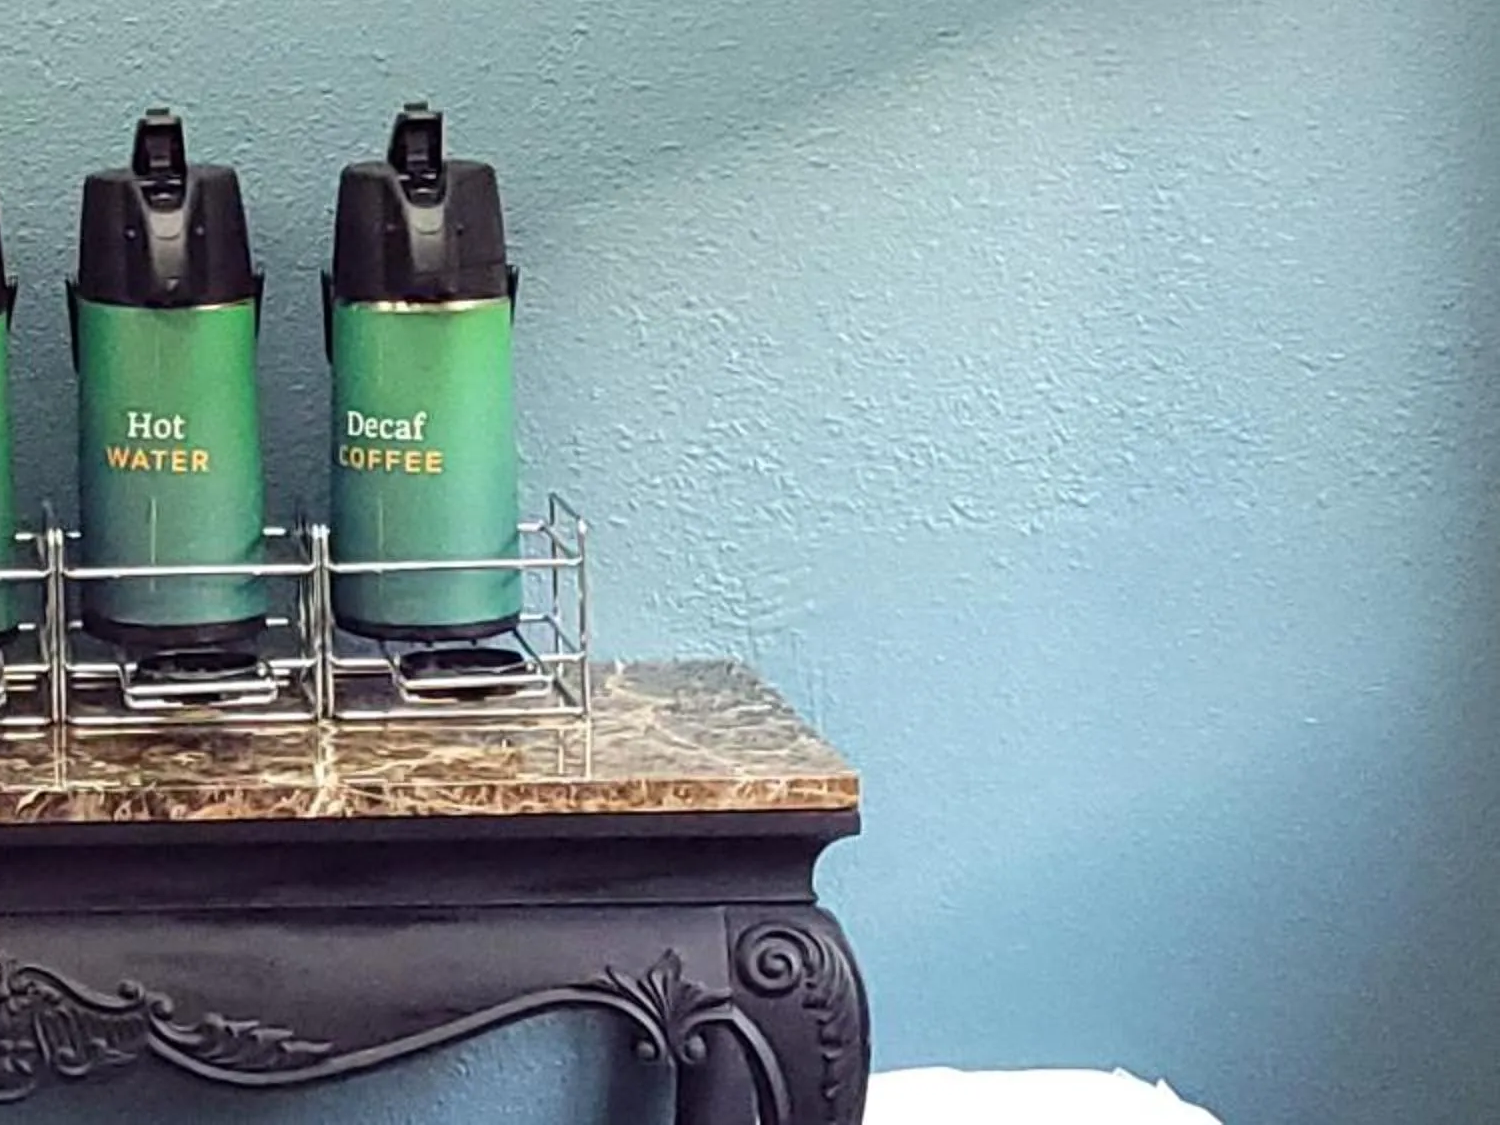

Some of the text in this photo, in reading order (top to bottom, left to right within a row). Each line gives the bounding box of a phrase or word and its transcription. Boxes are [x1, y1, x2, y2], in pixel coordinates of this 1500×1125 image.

[127, 411, 186, 440] Hot
[347, 410, 427, 441] Decaf
[106, 446, 210, 473] WATER
[339, 445, 444, 474] COFFEE
